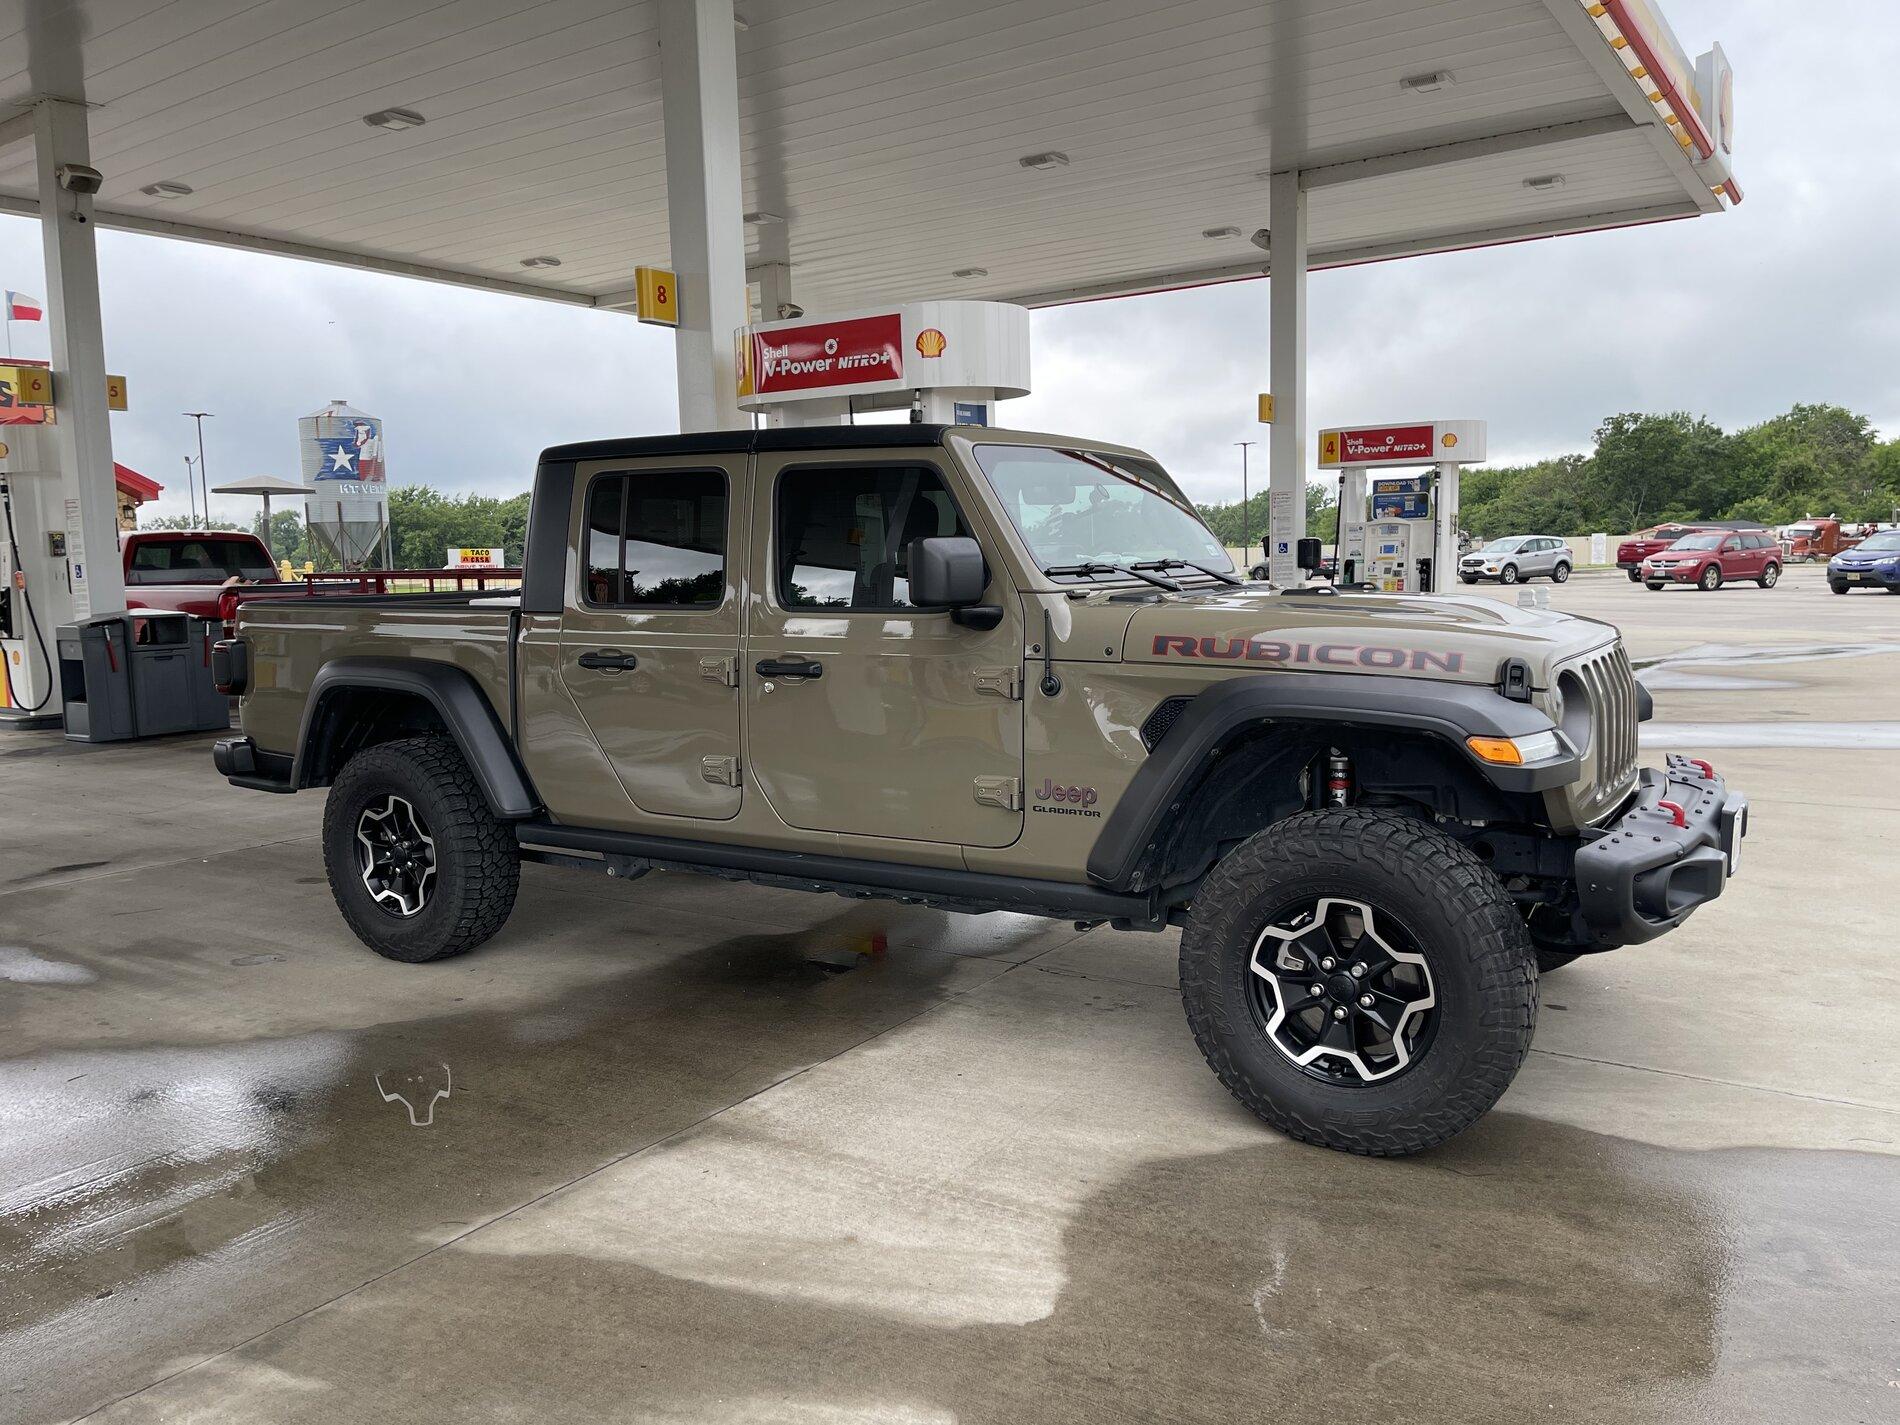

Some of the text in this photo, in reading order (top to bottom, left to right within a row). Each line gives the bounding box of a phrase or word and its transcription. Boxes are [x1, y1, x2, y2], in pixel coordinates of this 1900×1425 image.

[657, 285, 668, 304] 8
[763, 345, 789, 360] Shell
[765, 358, 834, 378] V-Power
[31, 379, 42, 391] 6
[109, 385, 119, 397] 5
[1325, 441, 1336, 455] 4
[1346, 438, 1364, 446] Shell
[1346, 445, 1390, 455] V-Power
[1151, 635, 1464, 673] RUBICON
[1035, 778, 1098, 809] Jeep
[1032, 805, 1101, 818] GLADIATOR
